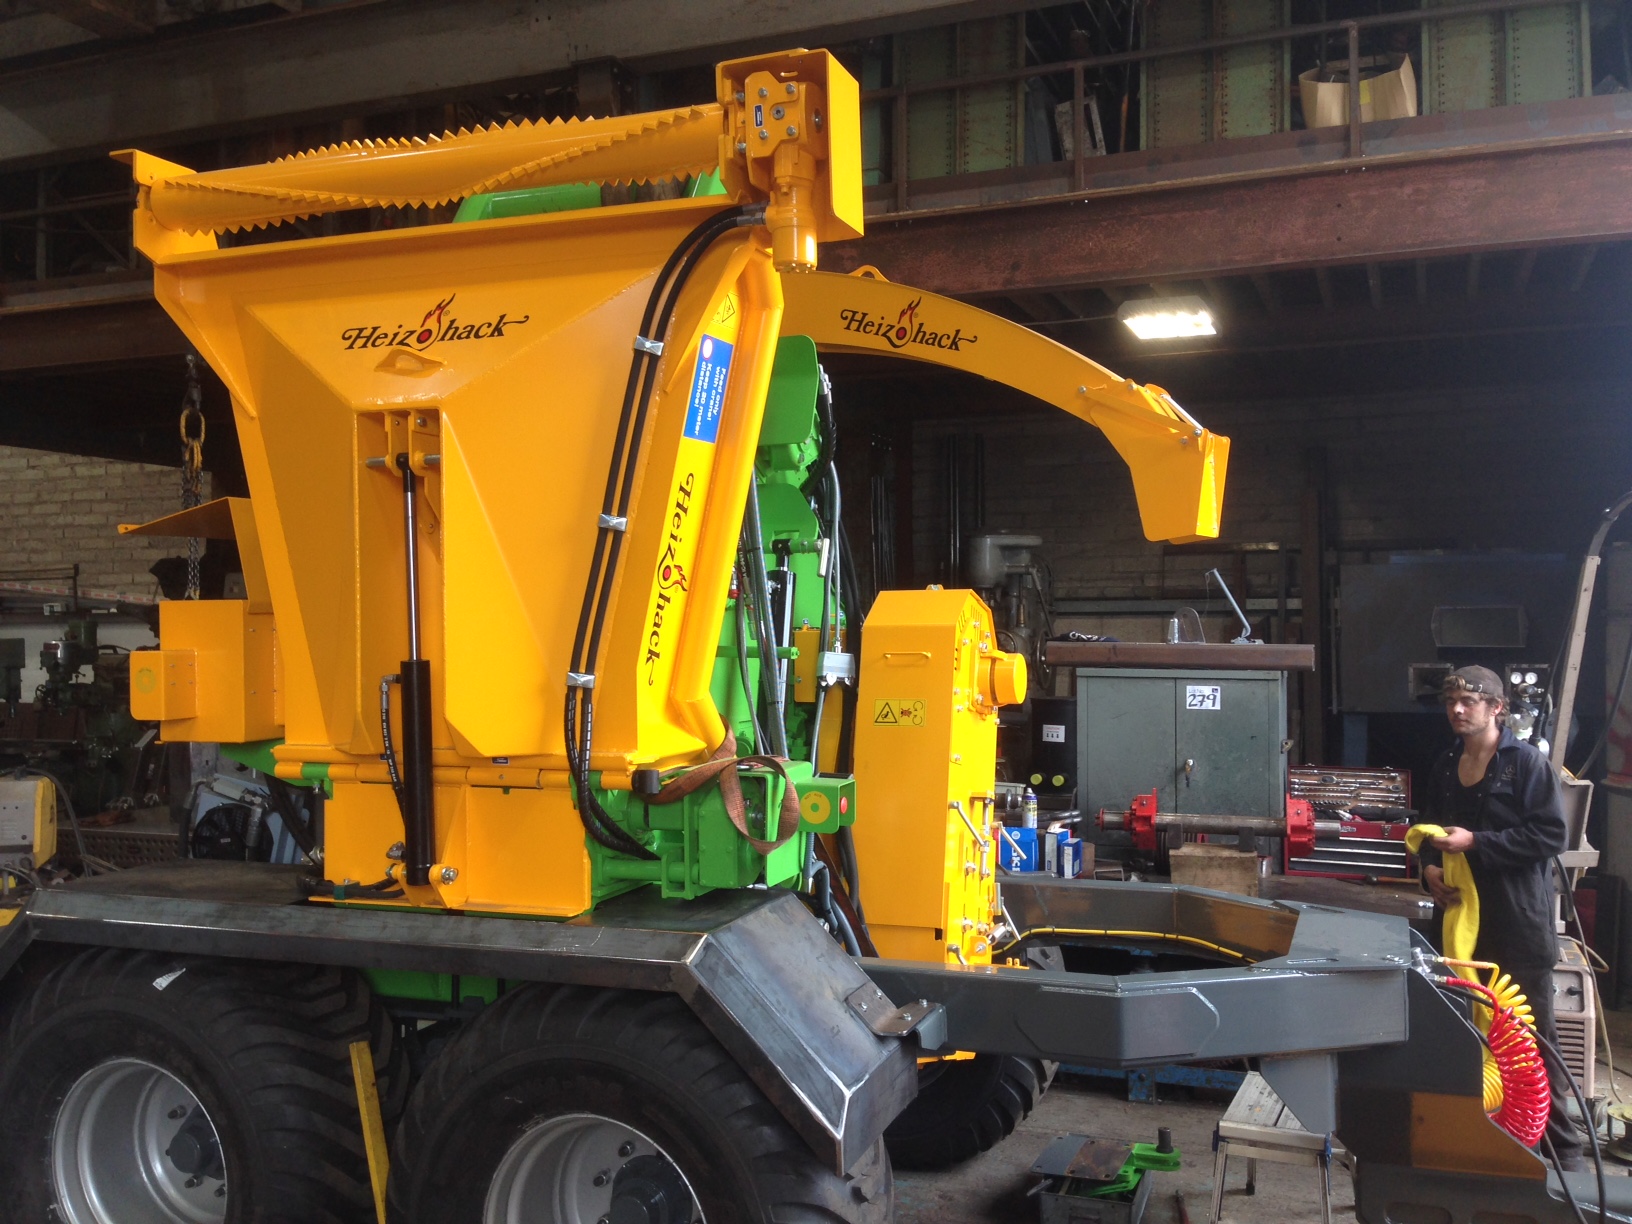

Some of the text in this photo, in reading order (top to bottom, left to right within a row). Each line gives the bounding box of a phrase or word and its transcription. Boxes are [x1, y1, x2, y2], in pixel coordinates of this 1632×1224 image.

[703, 363, 712, 389] Keep
[713, 366, 721, 388] with
[712, 368, 726, 416] Feed only
[694, 405, 703, 436] meter
[1188, 693, 1217, 708] 279
